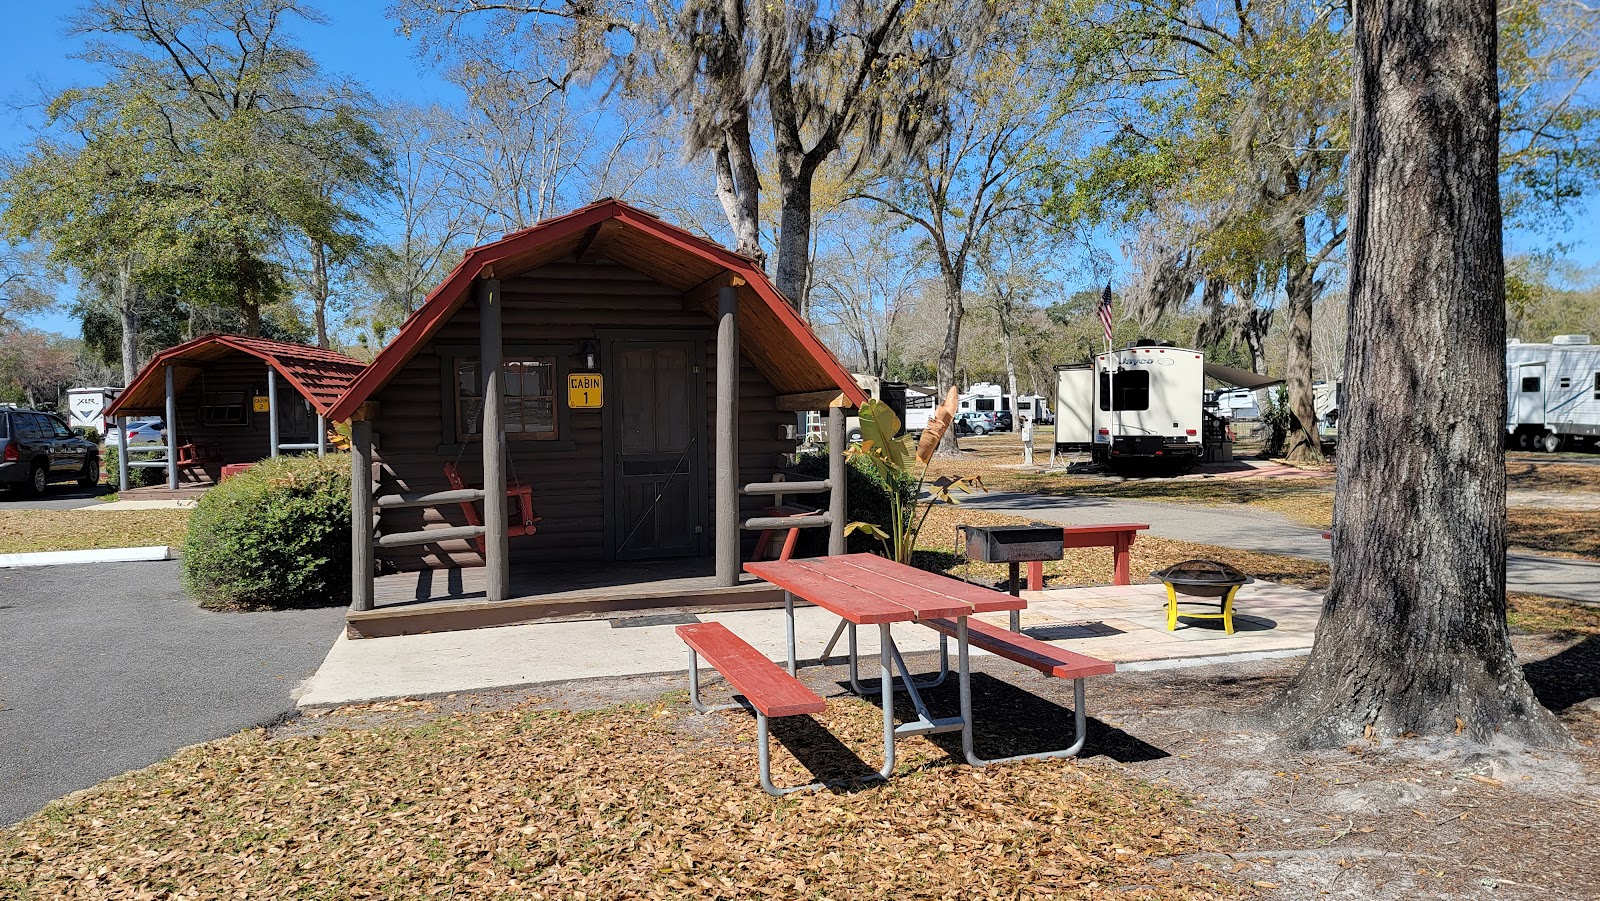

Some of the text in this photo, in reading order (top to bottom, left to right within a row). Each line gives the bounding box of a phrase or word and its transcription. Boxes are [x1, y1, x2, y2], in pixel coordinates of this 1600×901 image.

[571, 378, 600, 388] CABIN
[76, 398, 95, 406] XLR
[584, 392, 588, 404] 1
